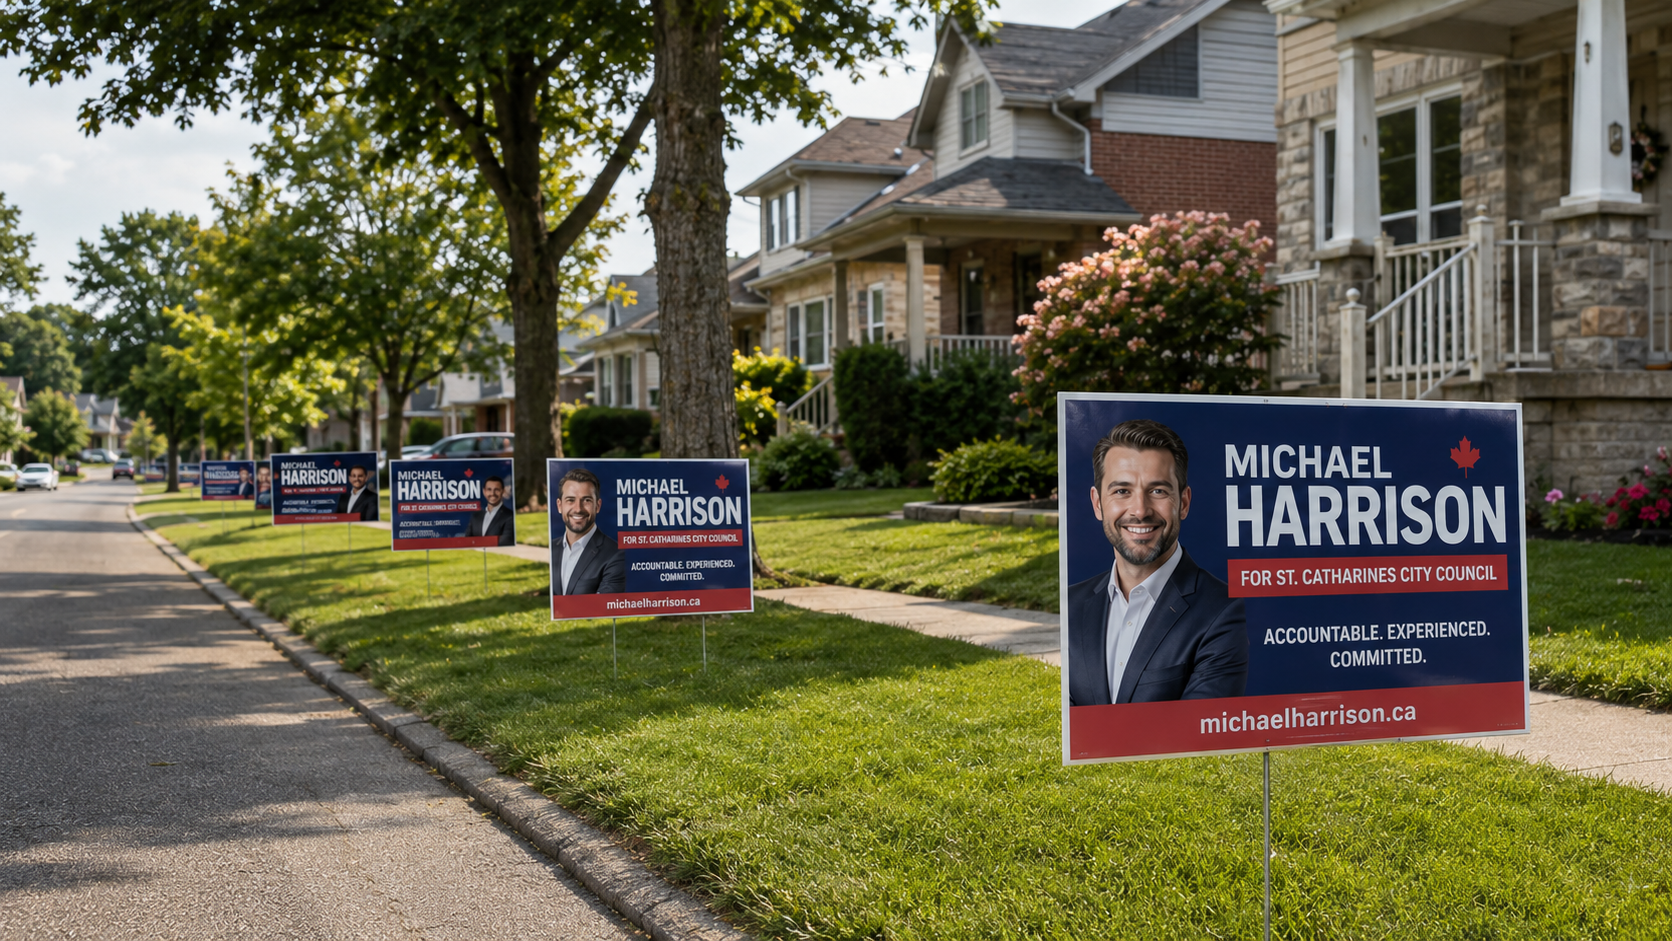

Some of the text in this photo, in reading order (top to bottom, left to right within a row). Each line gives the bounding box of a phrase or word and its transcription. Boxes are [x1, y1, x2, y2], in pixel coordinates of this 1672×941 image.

[1225, 444, 1392, 479] MICHAEL
[281, 468, 347, 486] HARRISON
[397, 470, 444, 481] MICHAEL
[397, 479, 481, 501] HARRISON
[616, 478, 689, 495] MICHAEL
[616, 496, 742, 527] HARRISON
[1225, 485, 1507, 547] HARRISON
[623, 536, 637, 545] FOR
[631, 559, 736, 571] ACCOUNTABLE. EXPERIENCED.
[660, 572, 705, 582] COMMITTED.
[1241, 565, 1497, 587] FOR ST. CATHARINES CITY COUNCIL
[606, 597, 701, 610] michaelharrison.ca
[1263, 621, 1491, 645] ACCOUNTABLE. EXPERIENCED.
[1330, 647, 1427, 668] COMMITTED.
[1201, 704, 1417, 734] michaelharrison.ca
